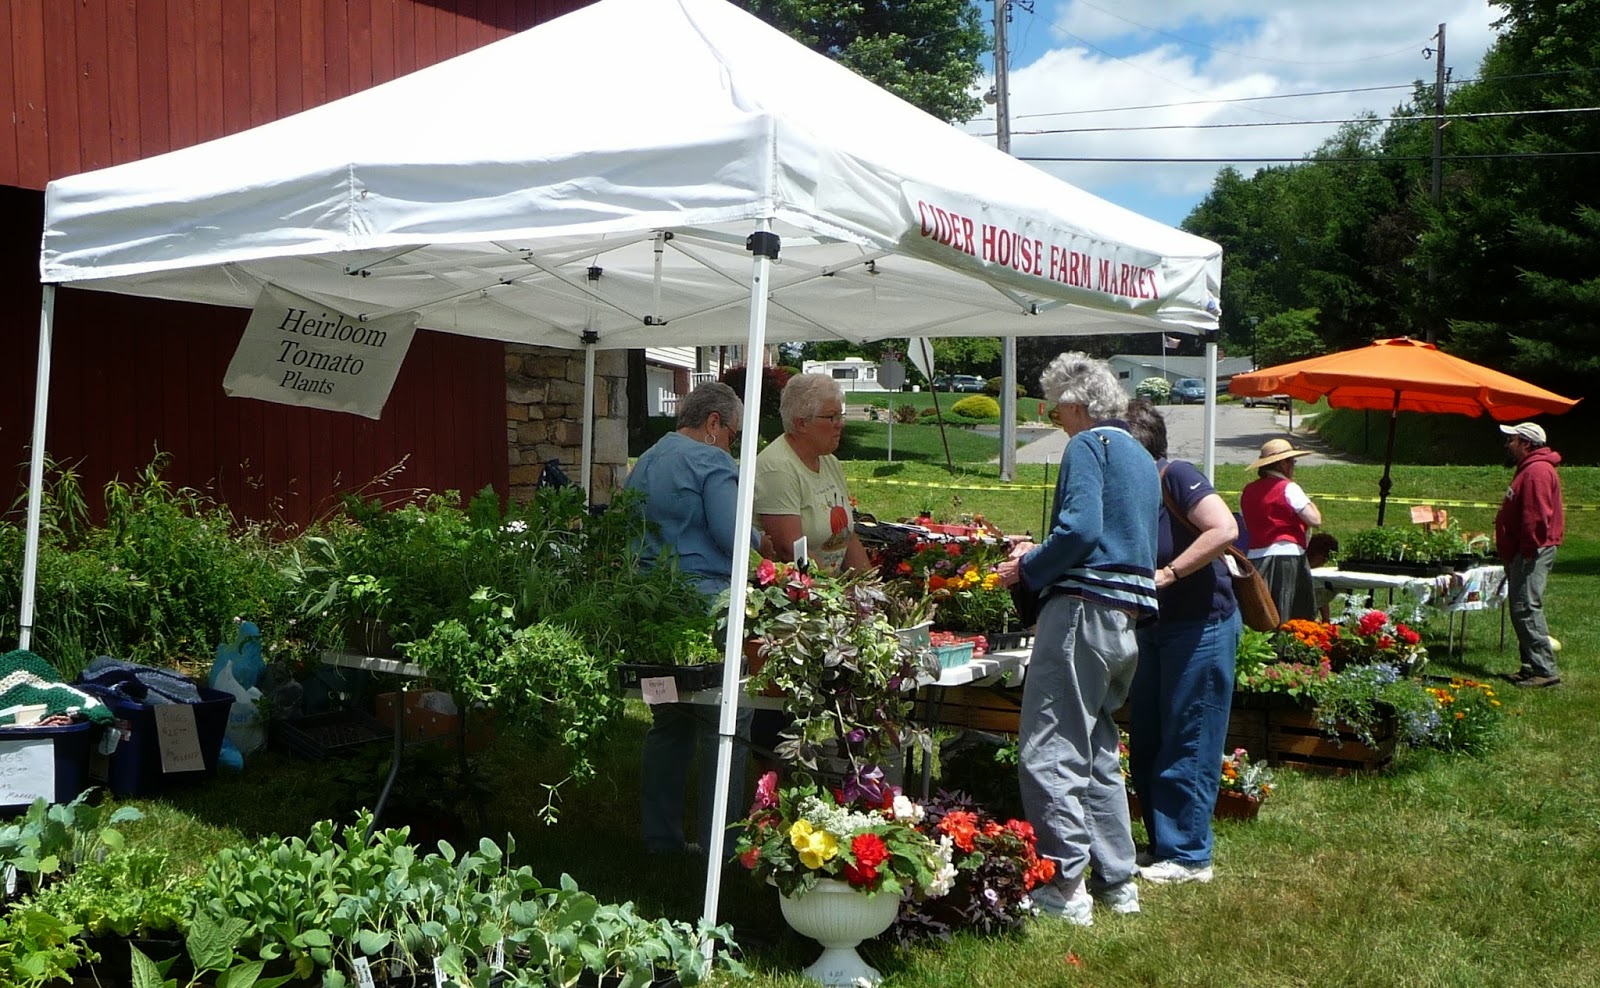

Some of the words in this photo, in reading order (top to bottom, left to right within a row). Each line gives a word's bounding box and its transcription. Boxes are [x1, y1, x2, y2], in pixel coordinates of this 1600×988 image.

[917, 200, 976, 256] CIDER
[982, 223, 1043, 277] HOUSE
[1049, 245, 1092, 290] FARM
[1097, 258, 1159, 300] MARKET
[277, 307, 388, 348] Heirloom
[276, 339, 365, 376] Tomato
[279, 370, 336, 395] Plants
